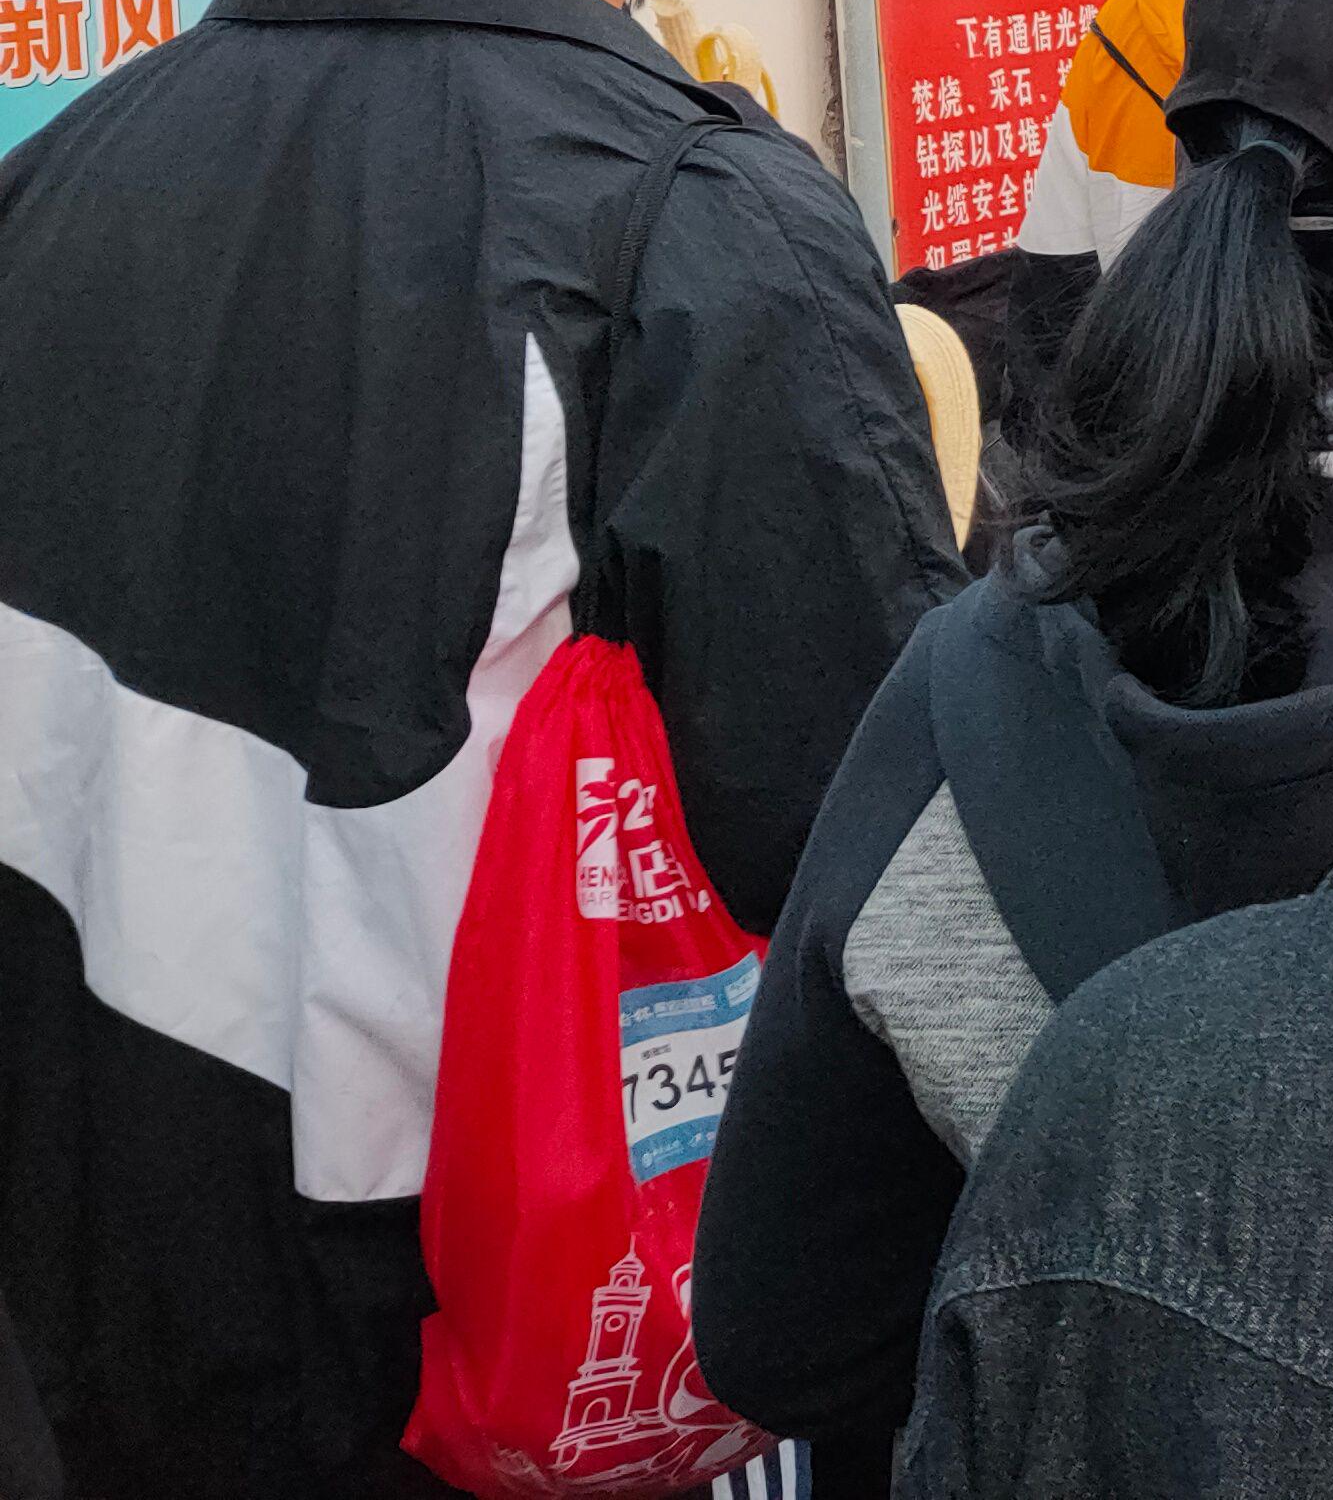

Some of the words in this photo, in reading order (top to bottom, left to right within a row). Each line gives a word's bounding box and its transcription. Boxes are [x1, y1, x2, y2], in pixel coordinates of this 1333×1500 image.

[916, 115, 1053, 179] 钻探以及堆
